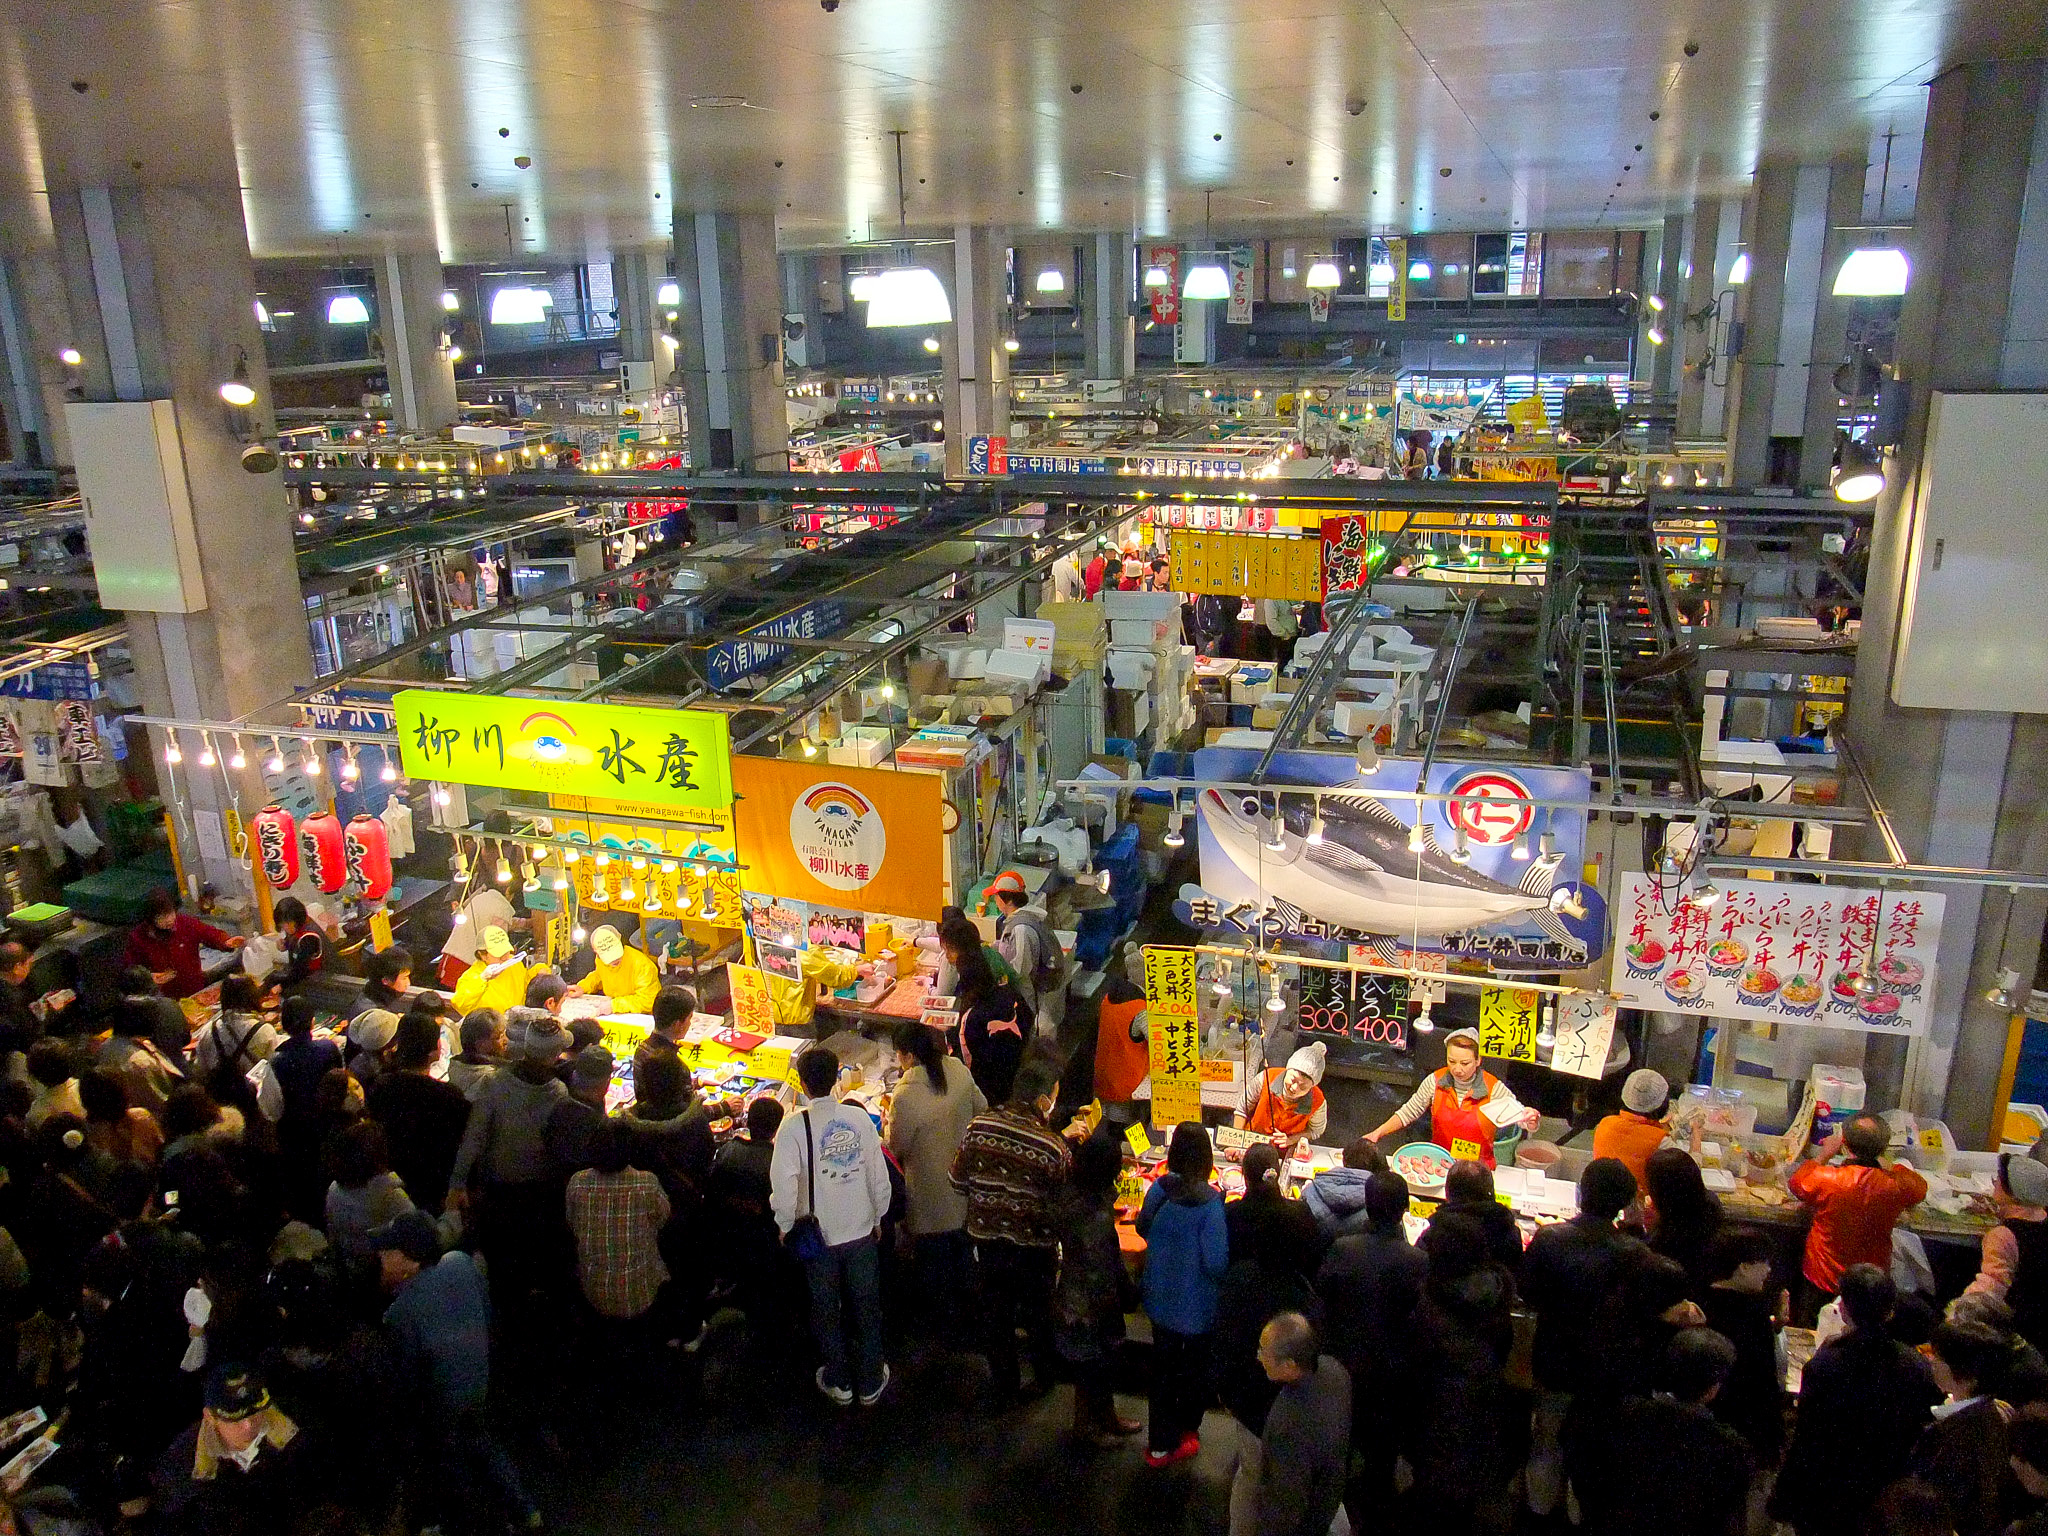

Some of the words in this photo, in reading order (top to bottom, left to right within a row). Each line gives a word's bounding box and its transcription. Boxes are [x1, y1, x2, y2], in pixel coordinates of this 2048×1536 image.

[1029, 457, 1079, 473] 中村商店
[1341, 519, 1365, 592] 海鮮
[413, 712, 504, 771] 柳川
[598, 728, 700, 791] 水産
[616, 803, 729, 821] www.yanagawa-fish.com
[814, 817, 863, 840] YANAGAWA
[823, 837, 854, 848] SUISAN
[809, 856, 870, 880] 柳川水産
[1630, 885, 1652, 945] いくら丼
[1720, 890, 1742, 939] とろ丼
[1739, 892, 1756, 924] うに
[1775, 893, 1791, 925] うに
[1753, 906, 1779, 970] いくら丼
[1787, 906, 1815, 972] うに丼
[1146, 950, 1161, 1004] うにとろ丼
[1162, 957, 1179, 1000] 三色丼
[1180, 954, 1195, 1004] 大とろ入り
[1327, 969, 1349, 1012] まぐろ
[1359, 972, 1386, 1019] 大とろ
[1387, 980, 1407, 1020] 極上
[1483, 988, 1506, 1056] サバ入荷
[1508, 1009, 1532, 1060] 済州島
[1565, 998, 1599, 1072] ふく汁
[1165, 1022, 1181, 1078] 中とろ丼
[1182, 1020, 1197, 1074] 本まぐろ
